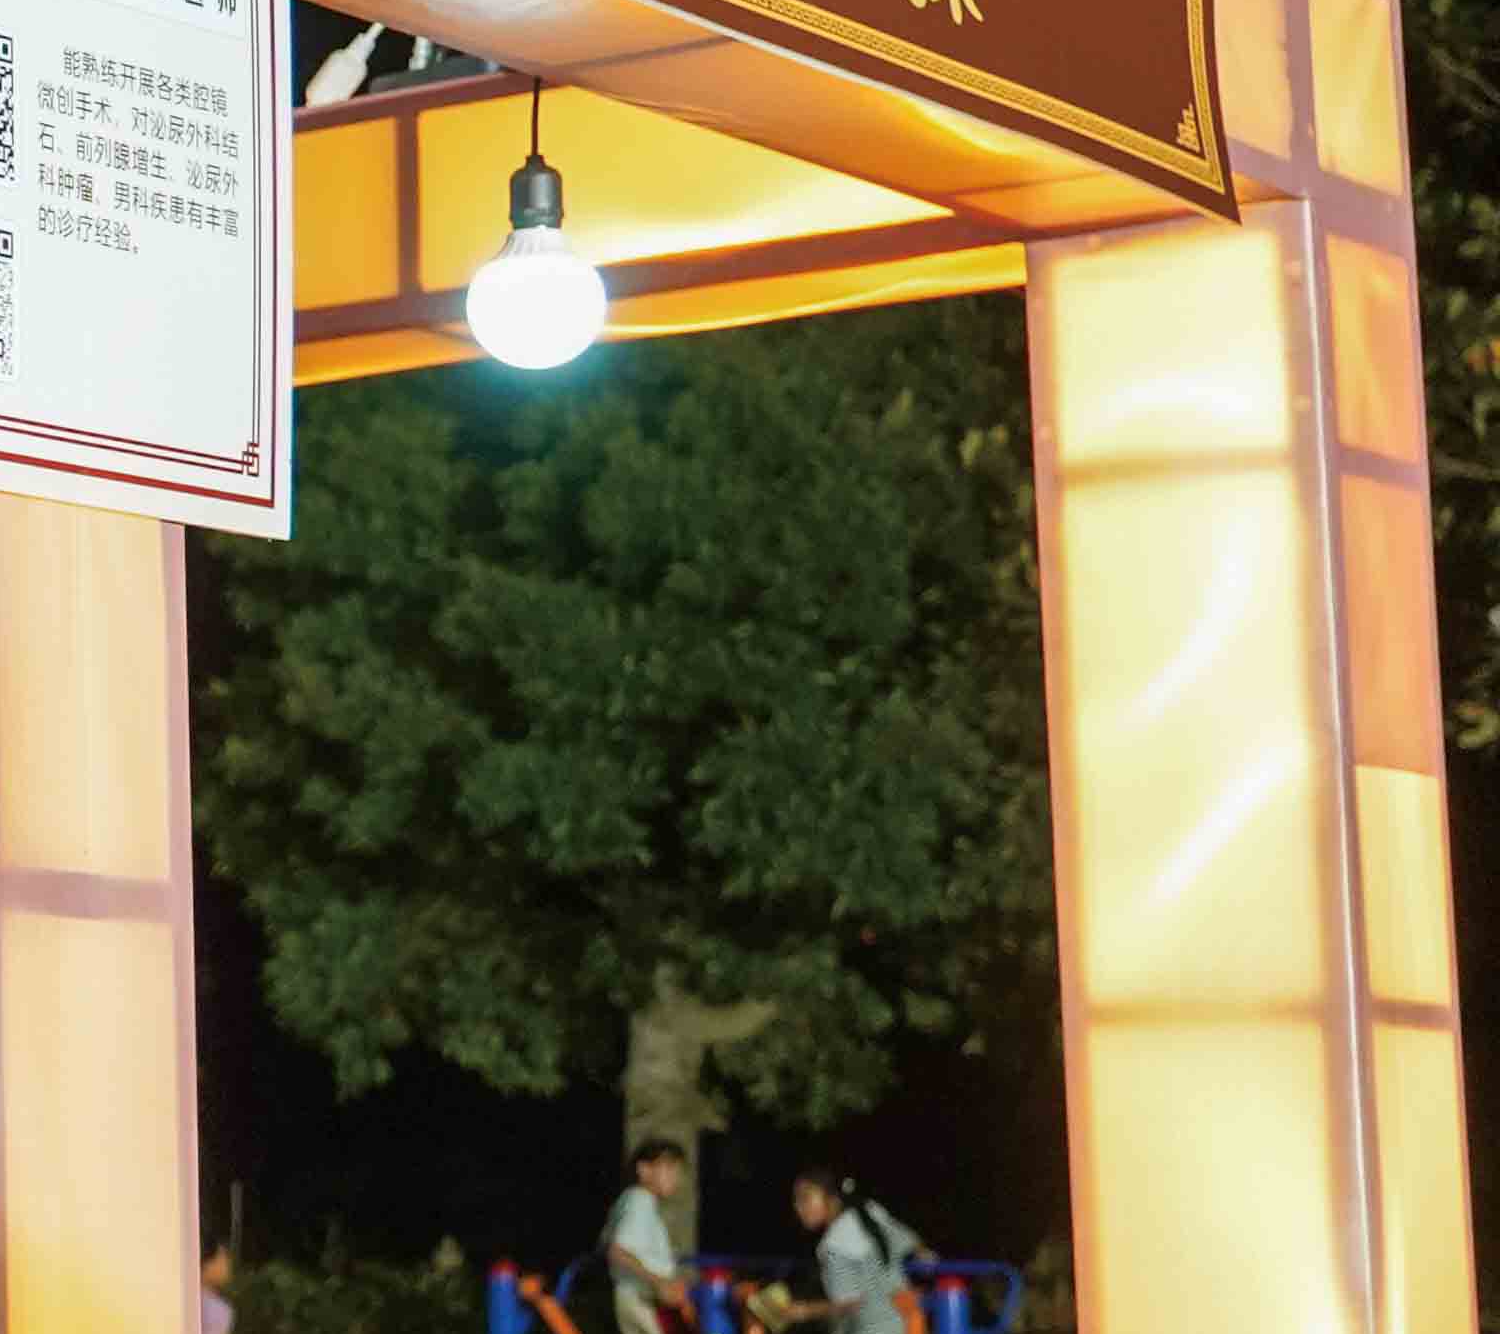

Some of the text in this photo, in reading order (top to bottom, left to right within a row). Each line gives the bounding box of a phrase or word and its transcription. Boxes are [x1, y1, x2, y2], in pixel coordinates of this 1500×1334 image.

[62, 45, 229, 118] 能熟练开展各类腔镜
[37, 162, 239, 238] 科肿瘤、男科疾患有丰富
[37, 203, 139, 255] 的诊疗经验。
